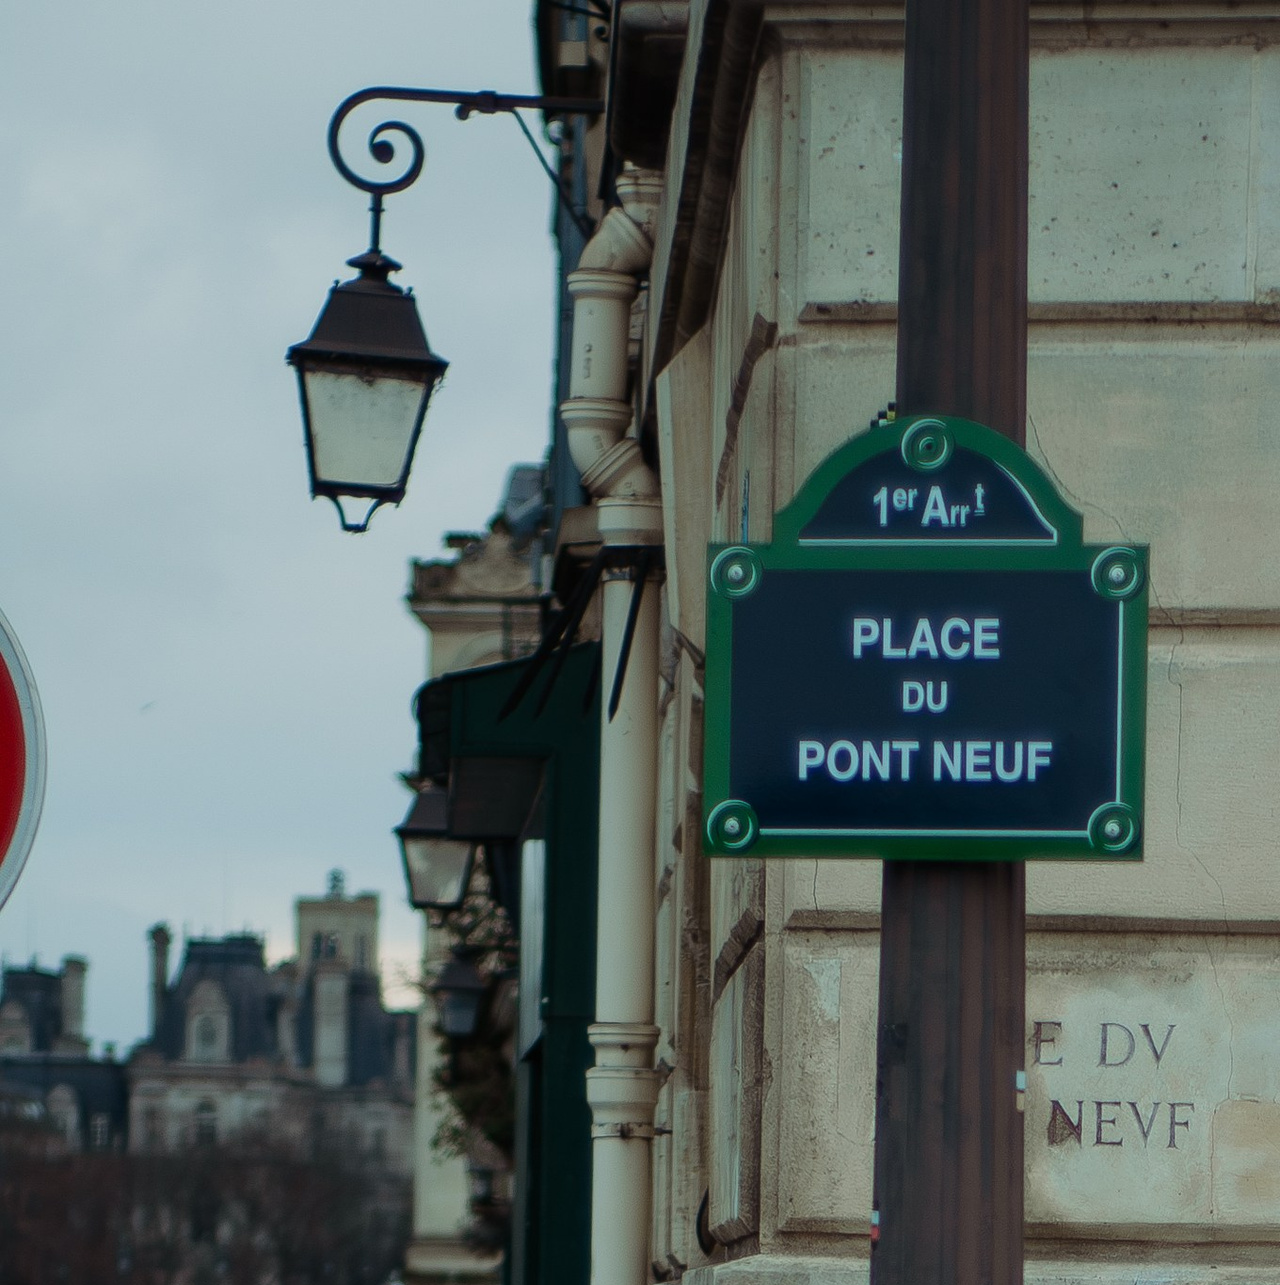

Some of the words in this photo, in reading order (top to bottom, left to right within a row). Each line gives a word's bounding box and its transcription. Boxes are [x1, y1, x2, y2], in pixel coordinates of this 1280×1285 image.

[853, 618, 1000, 659] PLACE
[901, 680, 948, 714] DU
[797, 740, 919, 782] PONT
[932, 740, 1053, 783] NEUF
[1097, 1022, 1176, 1069] DV
[1047, 1099, 1195, 1149] NEVF
